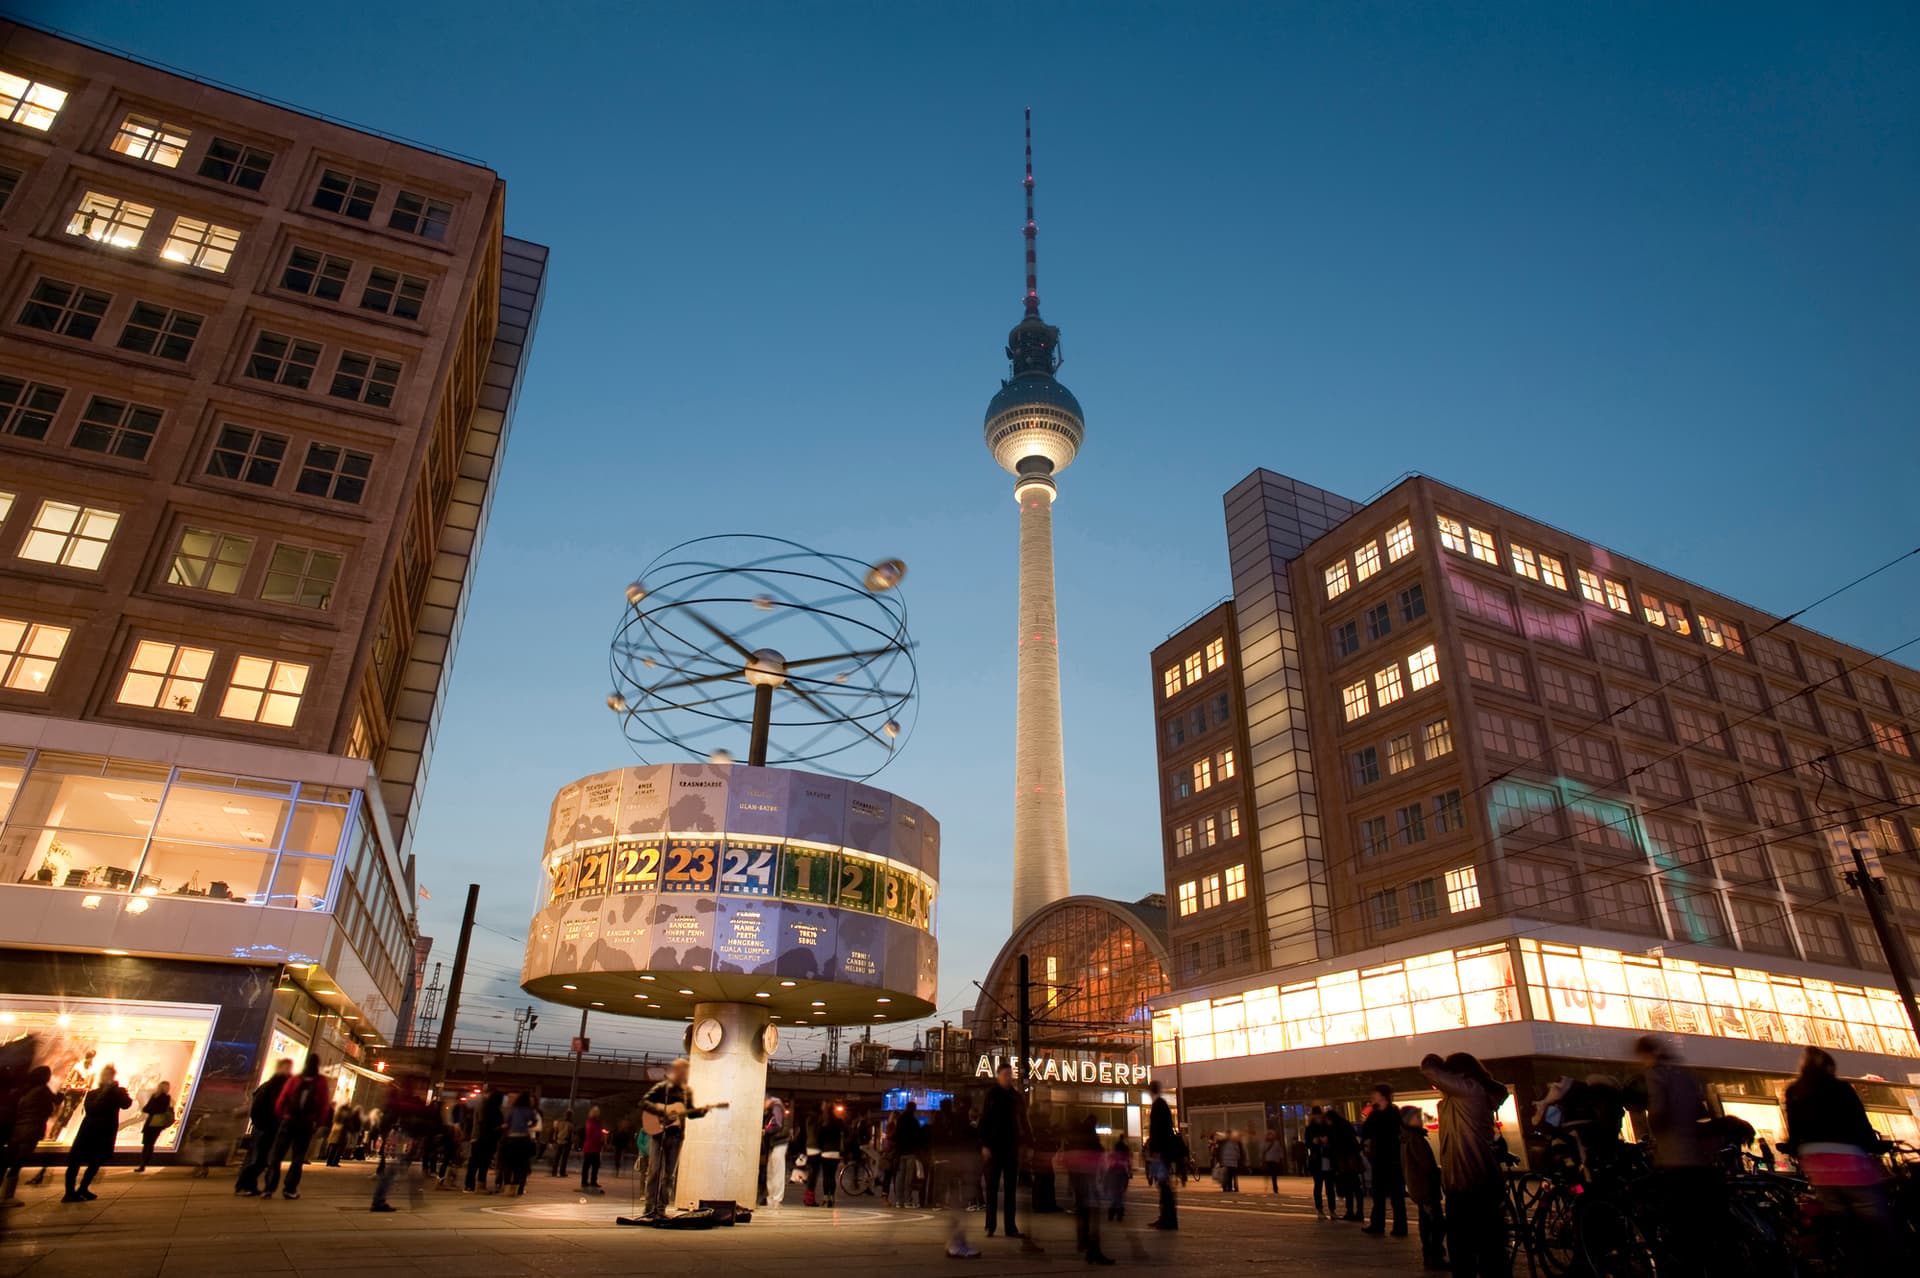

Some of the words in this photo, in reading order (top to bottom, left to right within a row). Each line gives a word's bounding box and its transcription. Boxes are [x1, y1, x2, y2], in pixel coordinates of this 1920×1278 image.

[579, 853, 610, 888] 21
[615, 848, 660, 883] 22
[664, 847, 715, 882] 23
[722, 849, 771, 886] 24
[794, 856, 812, 891] 1
[840, 865, 864, 900] 2
[886, 876, 899, 909] 3
[733, 924, 761, 932] MANILA
[736, 932, 758, 940] PERTH
[727, 939, 765, 947] HONGKONG
[798, 937, 817, 946] SEOUL
[720, 945, 742, 953] KUALA
[744, 946, 770, 955] LUMPUR
